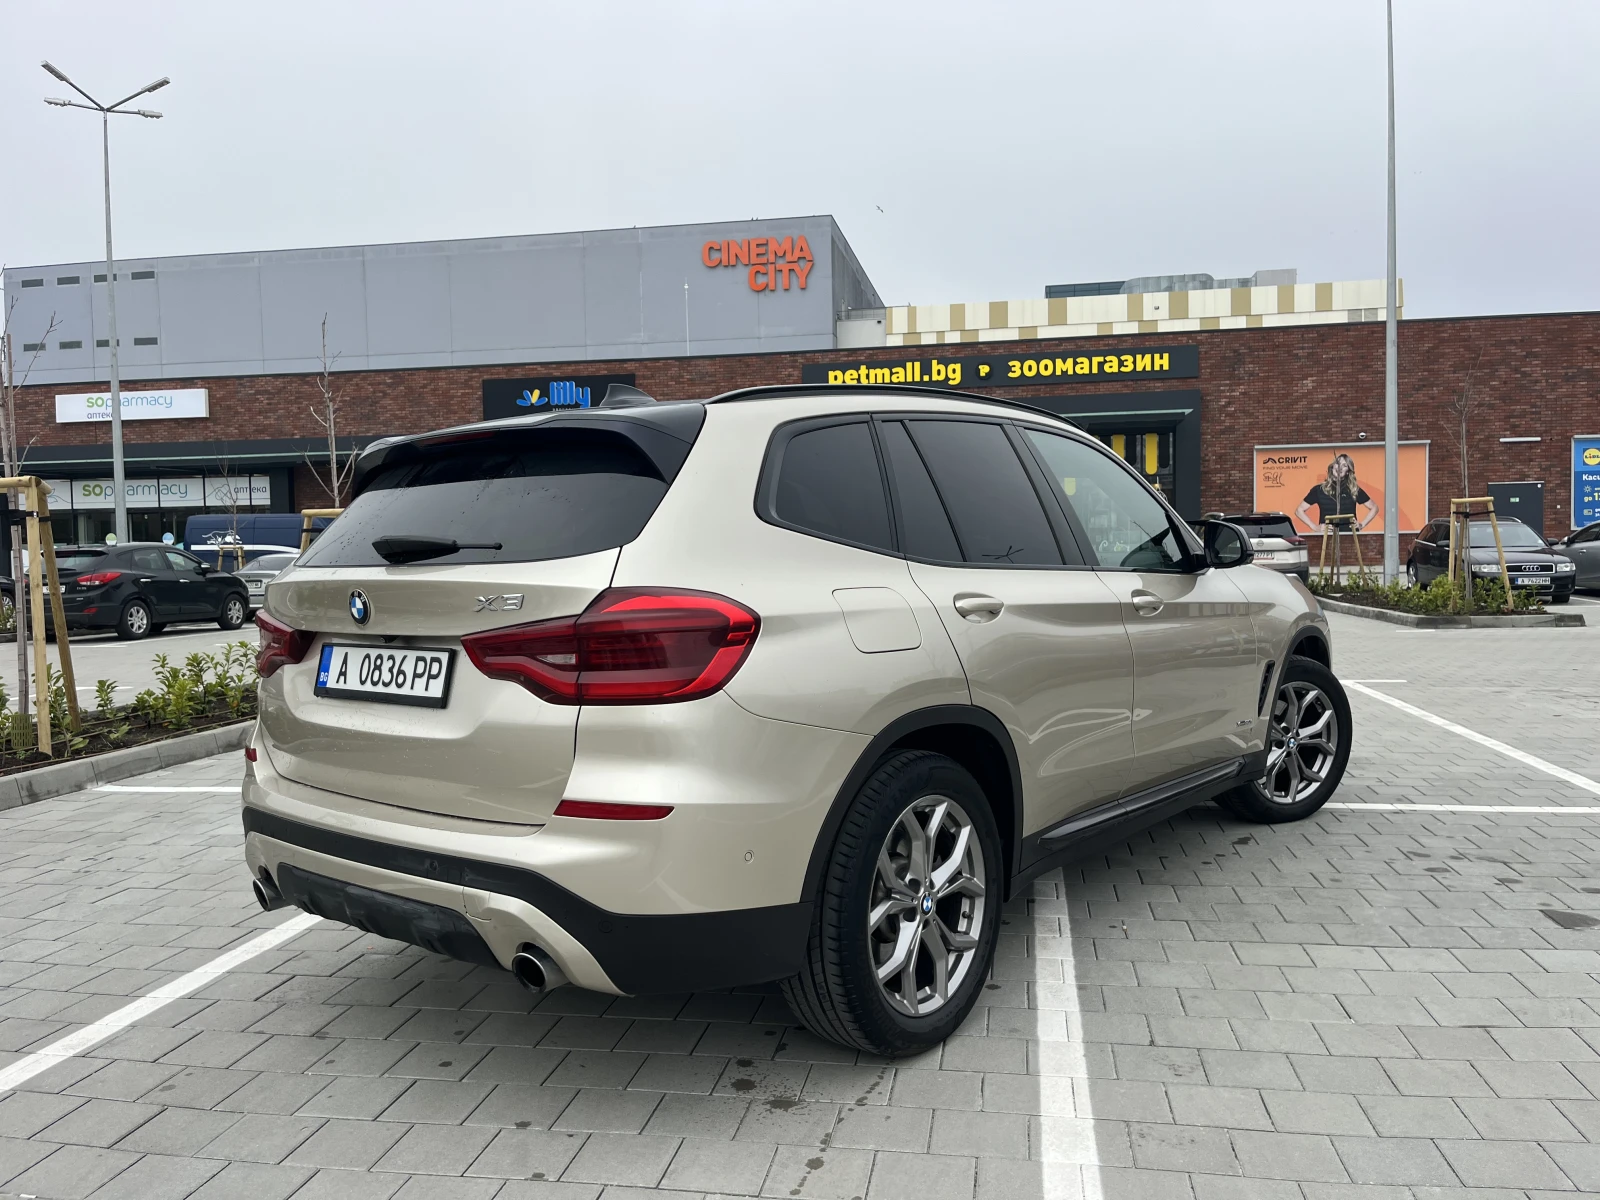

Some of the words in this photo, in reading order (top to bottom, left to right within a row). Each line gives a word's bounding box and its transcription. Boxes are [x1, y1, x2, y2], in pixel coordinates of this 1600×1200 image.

[702, 235, 814, 268] CINEMA
[748, 262, 814, 292] CITY
[828, 359, 962, 386] petmall.bg
[1007, 352, 1170, 378] зоомагазин
[86, 395, 173, 411] soparmacy
[549, 380, 591, 409] lilly
[86, 412, 113, 420] аптек
[1277, 456, 1308, 464] CRIVIT
[82, 483, 188, 501] soparmacy
[233, 486, 267, 494] аптека
[473, 593, 525, 613] X3
